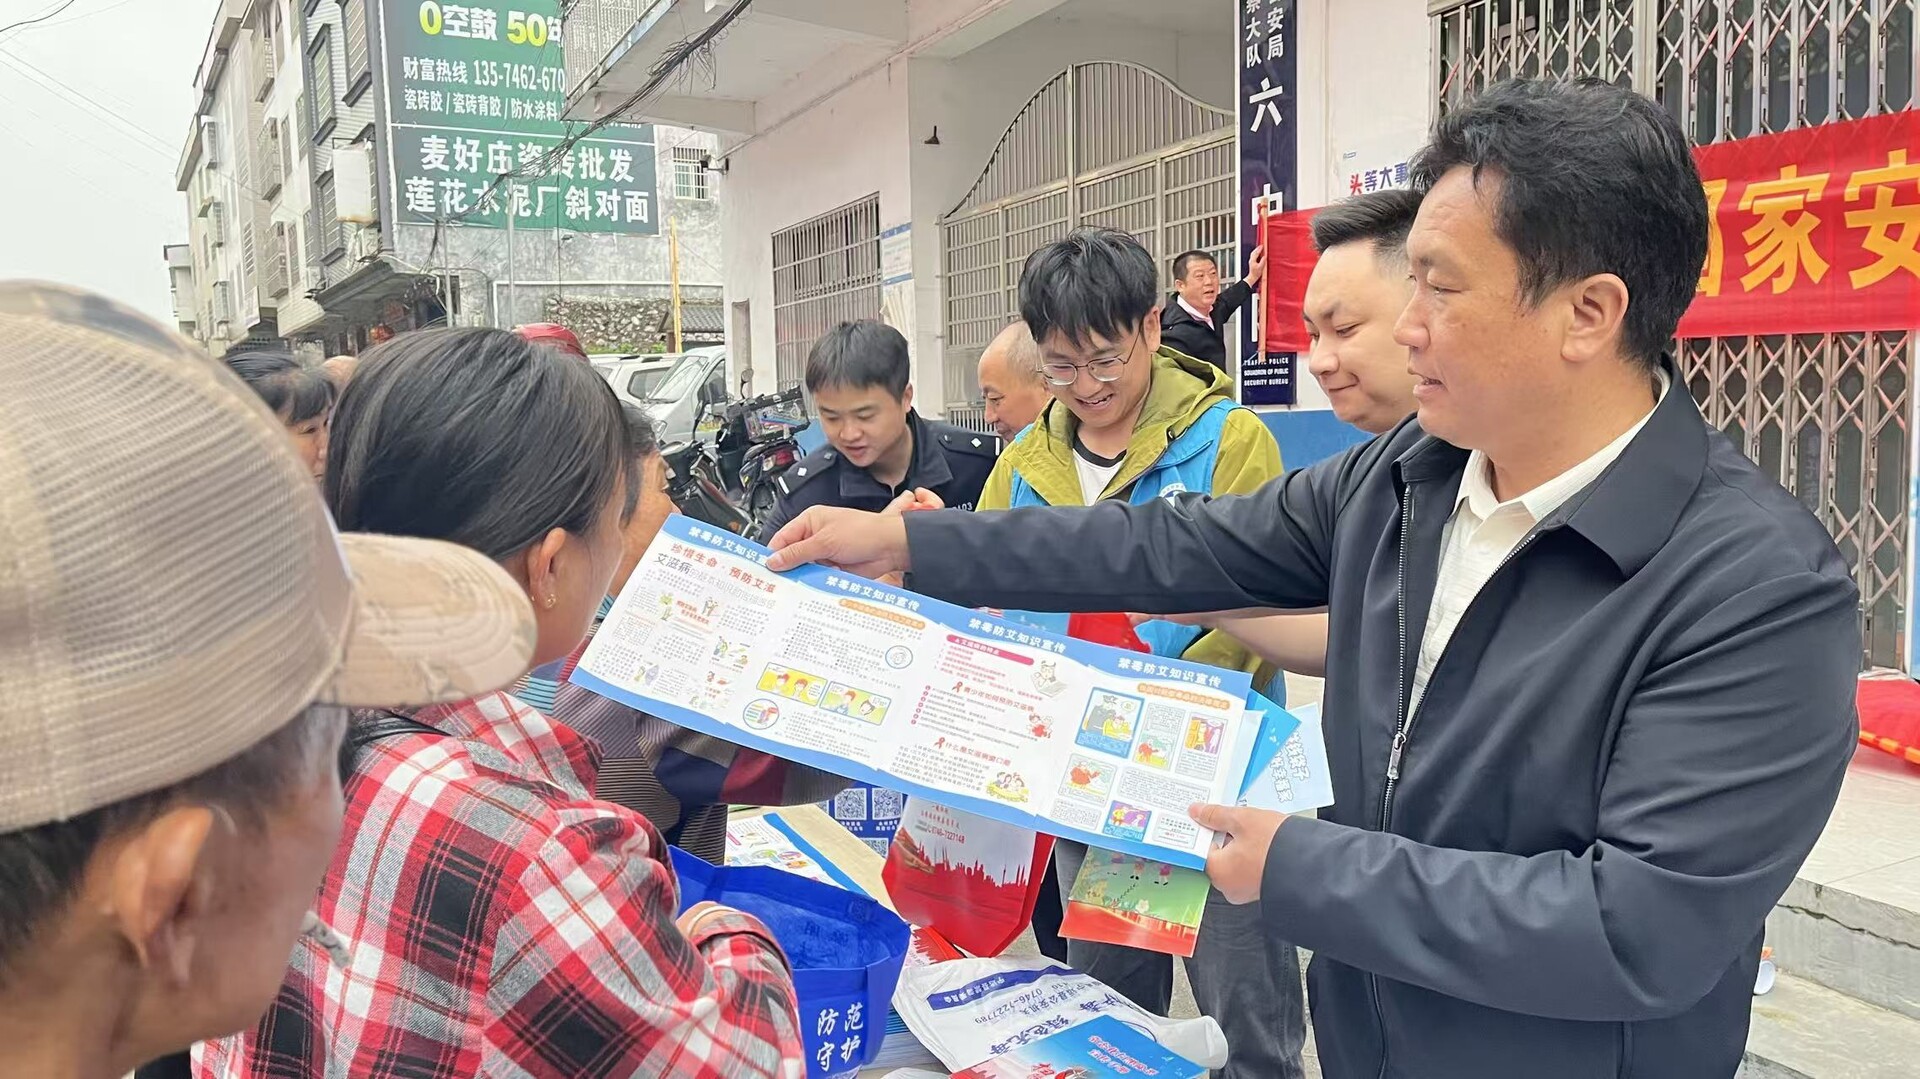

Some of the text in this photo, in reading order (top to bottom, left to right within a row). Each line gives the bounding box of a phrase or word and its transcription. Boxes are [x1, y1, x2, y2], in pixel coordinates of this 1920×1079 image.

[1267, 0, 1284, 60] 安局
[403, 57, 468, 85] 财富热线
[420, 135, 635, 183] 麦好庄瓷砖批发
[1350, 162, 1408, 196] 头等大事
[404, 176, 650, 223] 莲花水泥厂斜对面
[1269, 357, 1289, 365] POLICE
[1244, 378, 1289, 387] SECURITY BUREAU
[825, 575, 922, 612] 禁毒防艾知识宣传
[968, 619, 1068, 655] 禁毒防艾知识宣传
[1117, 657, 1223, 689] 禁毒防艾知识宣传
[817, 1002, 864, 1036] 防范
[816, 1034, 862, 1072] 守护
